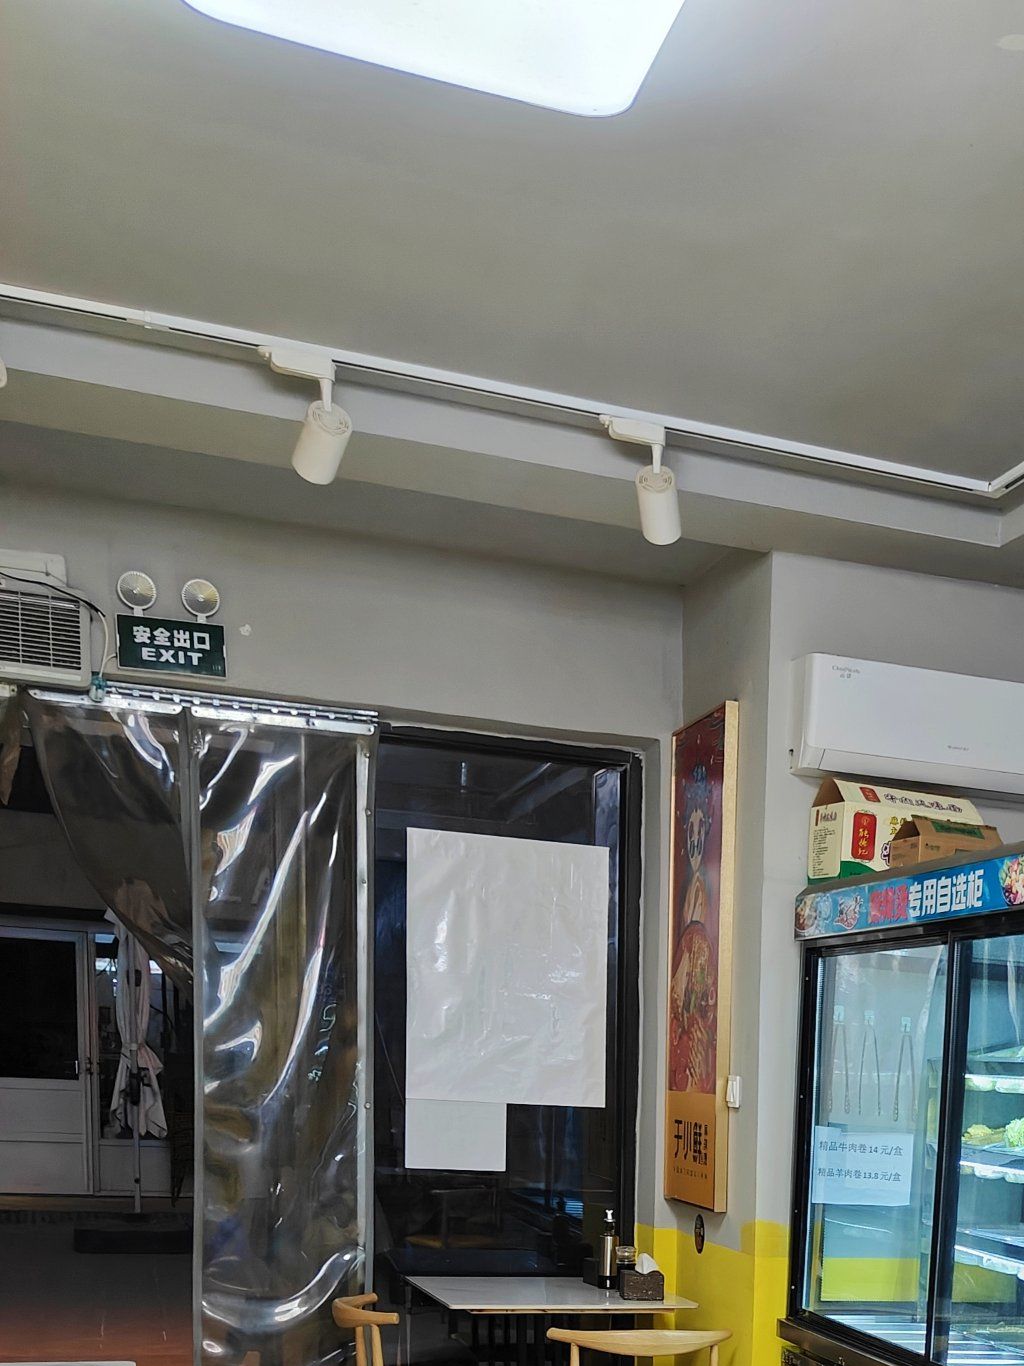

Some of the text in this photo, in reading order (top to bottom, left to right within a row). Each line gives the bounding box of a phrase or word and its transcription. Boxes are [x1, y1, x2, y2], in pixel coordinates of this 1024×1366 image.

[132, 625, 211, 651] 安全出口
[141, 646, 203, 666] EXIT
